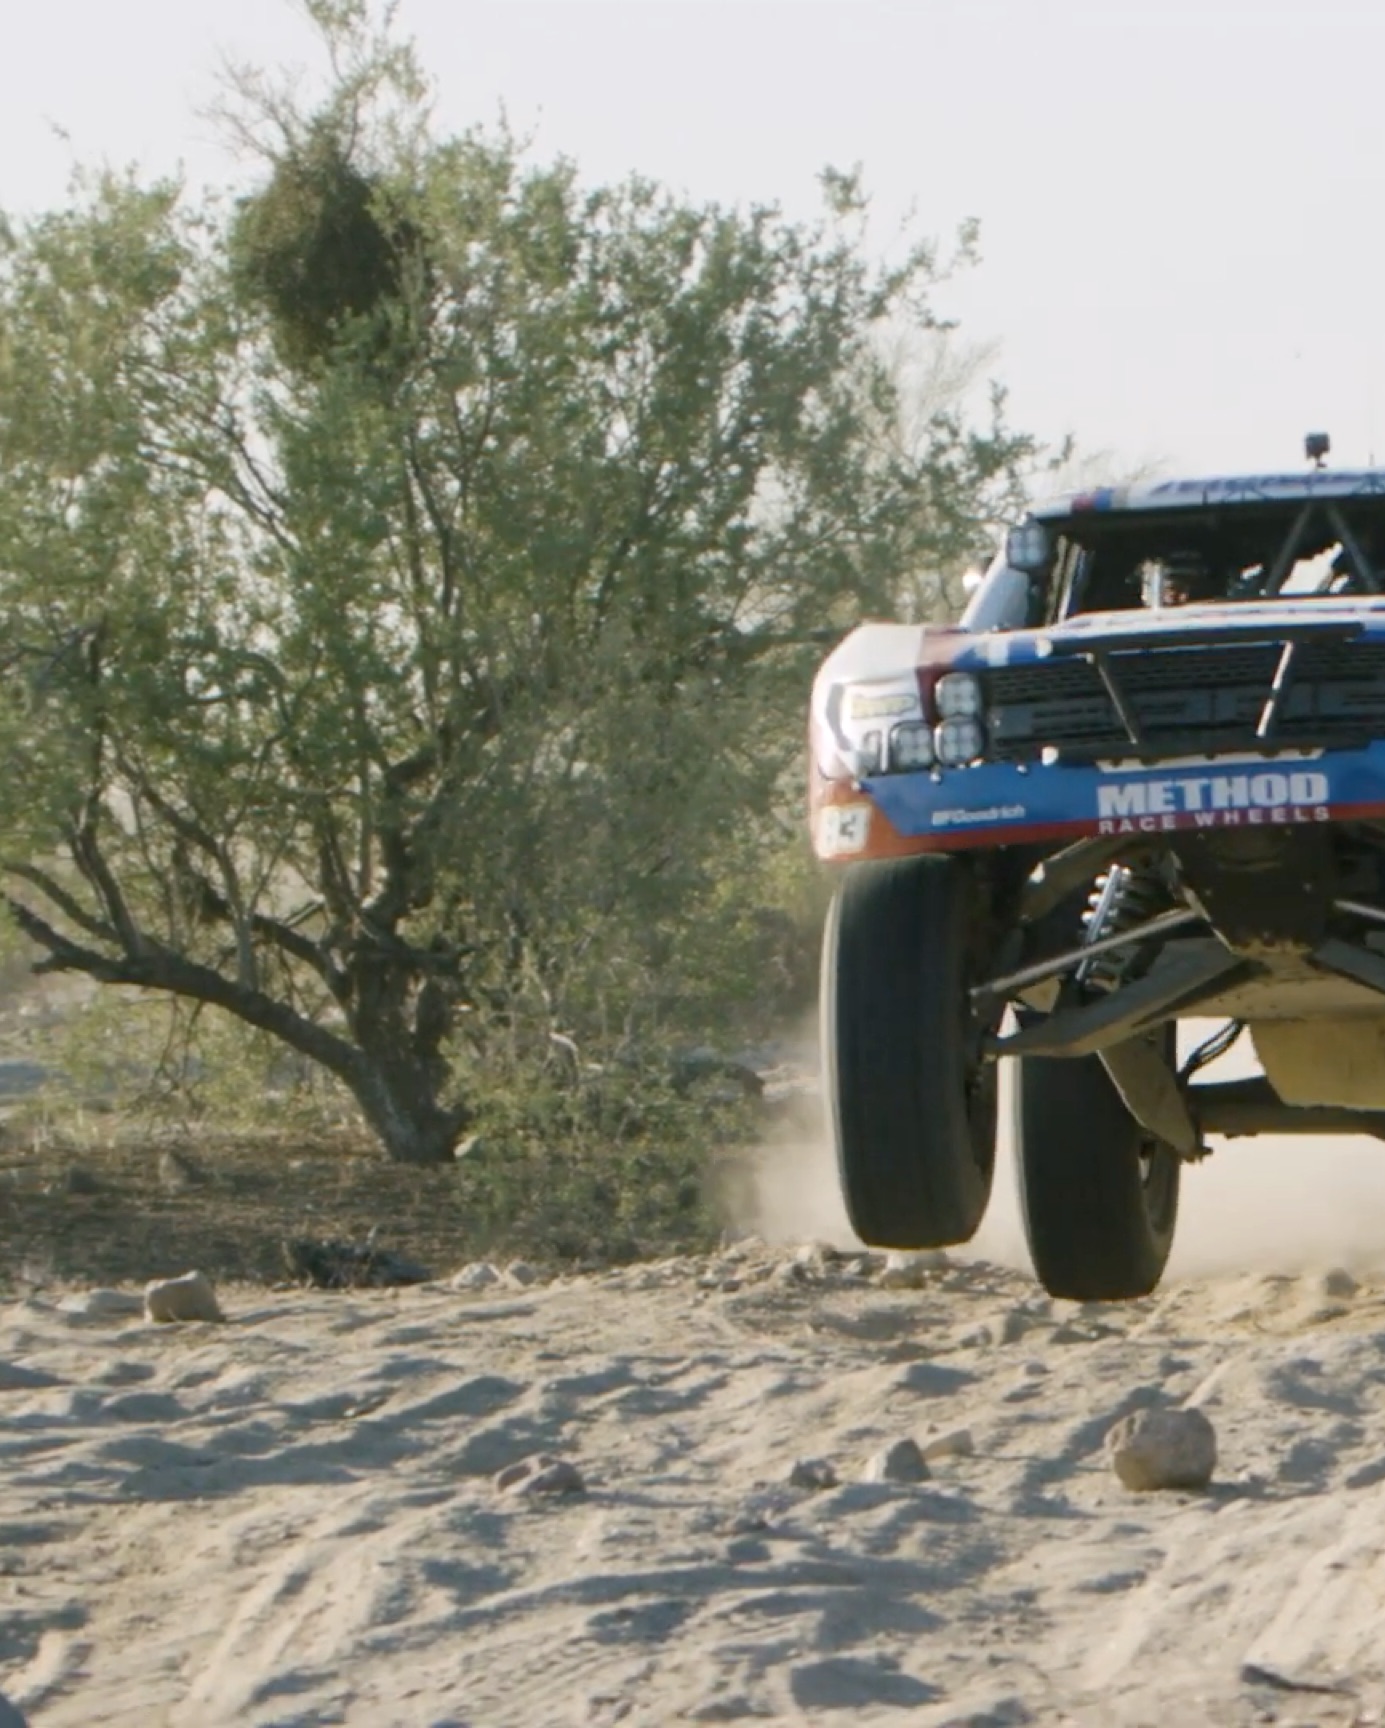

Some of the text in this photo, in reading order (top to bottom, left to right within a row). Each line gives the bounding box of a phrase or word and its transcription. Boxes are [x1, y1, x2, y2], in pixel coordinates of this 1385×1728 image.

[1097, 772, 1329, 818] METHOD
[1099, 805, 1331, 835] RACE WHEELS
